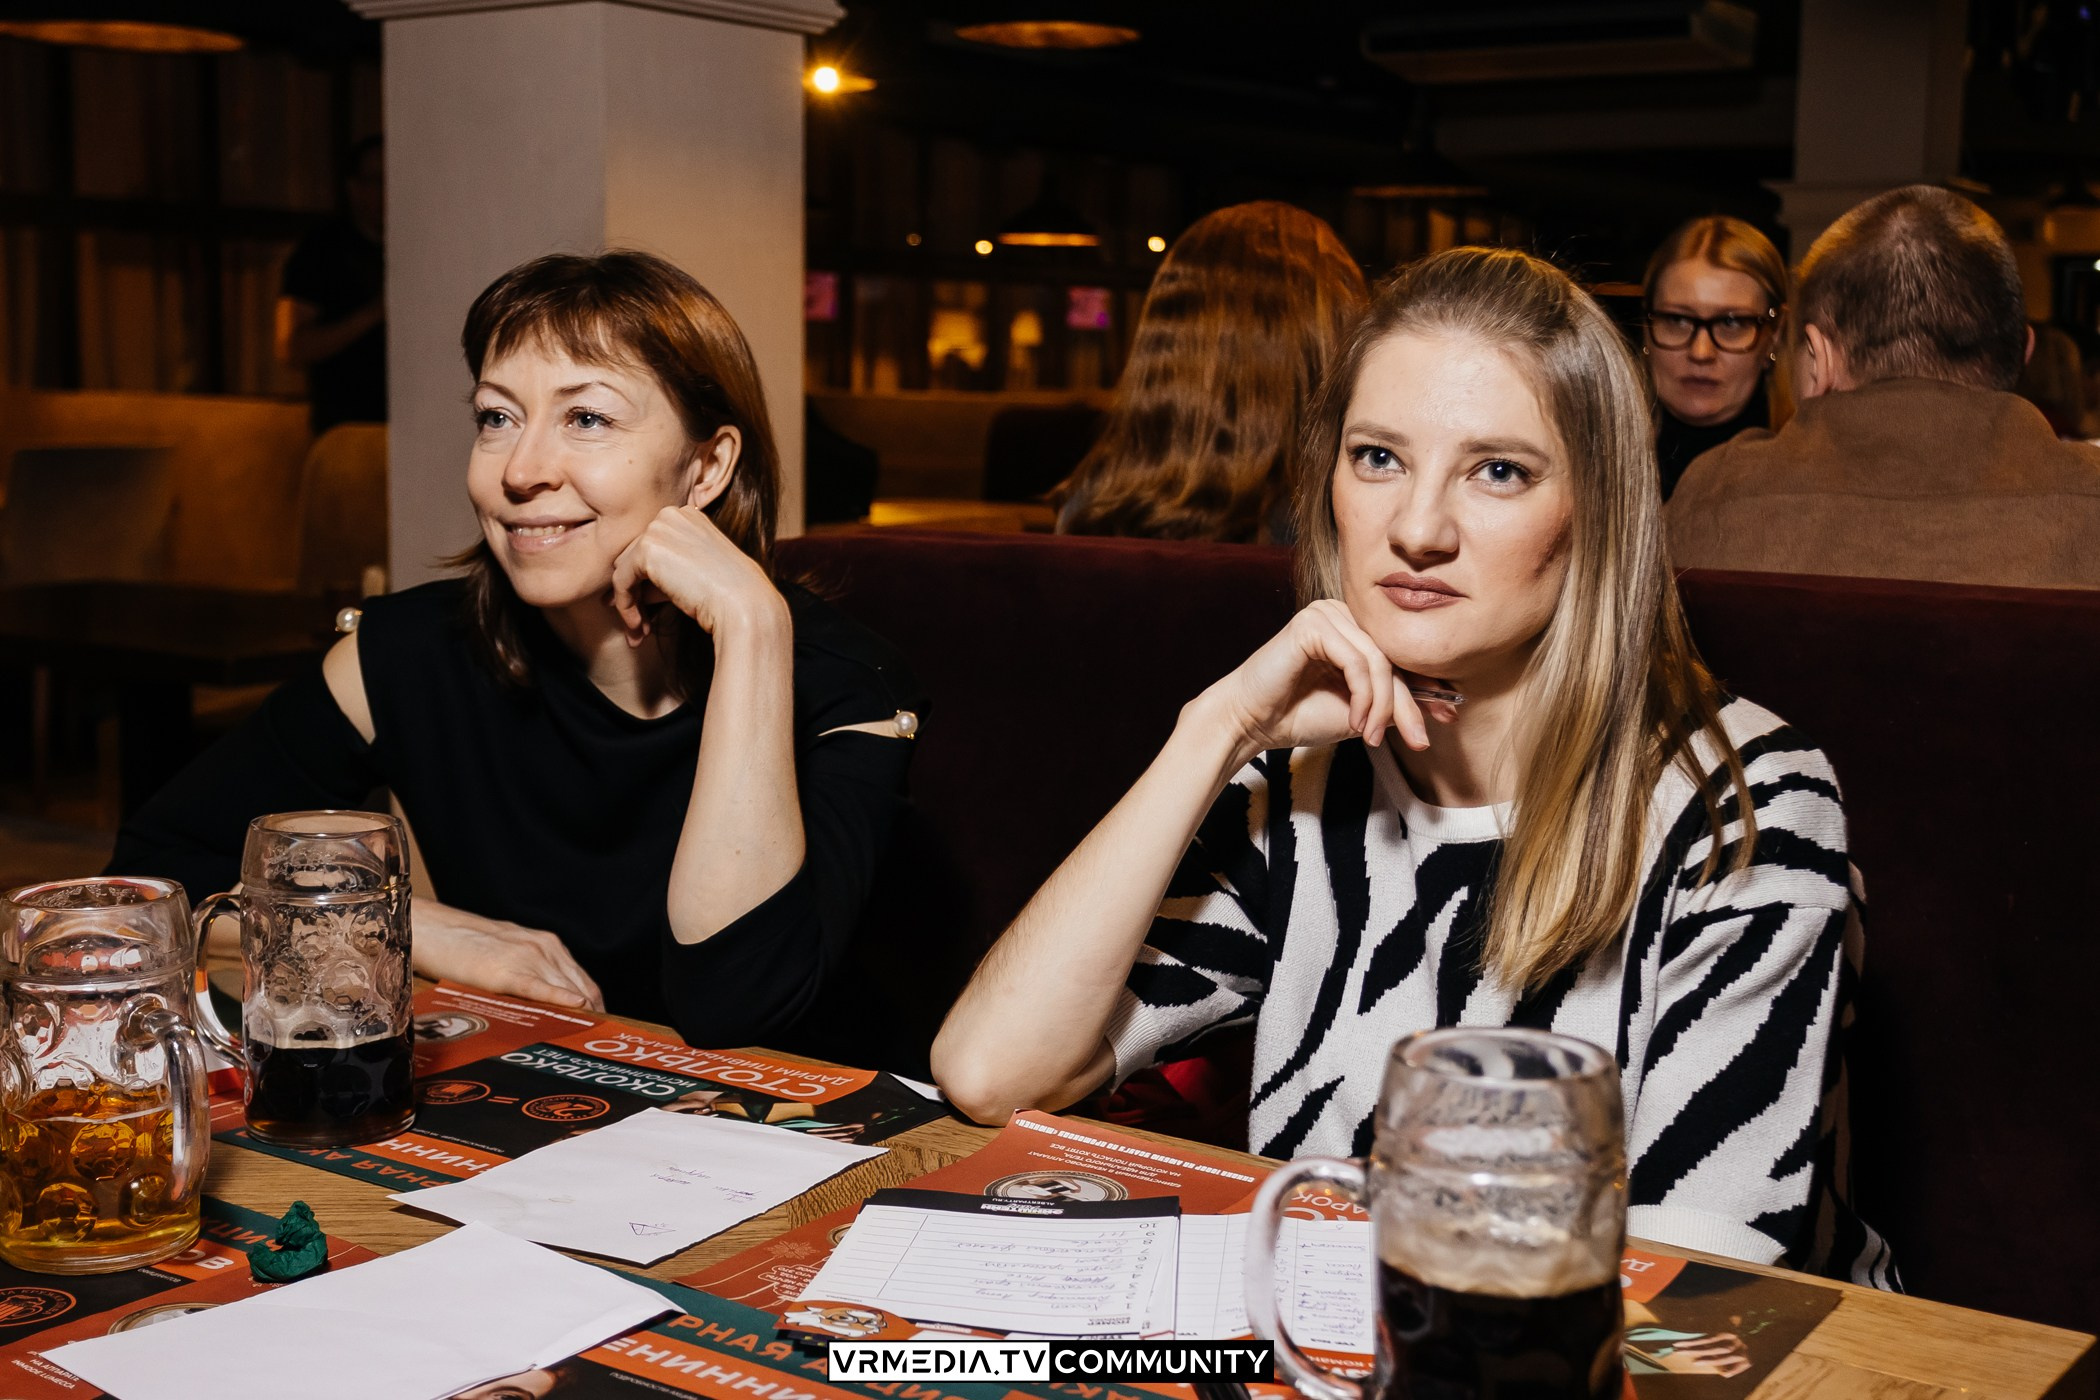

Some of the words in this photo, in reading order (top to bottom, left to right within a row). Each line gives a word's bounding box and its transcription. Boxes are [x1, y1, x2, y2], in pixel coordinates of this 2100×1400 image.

[611, 1032, 683, 1052] МАРОК
[532, 1048, 567, 1061] ЛЕТ
[685, 1048, 773, 1071] ПИВНЫХ
[500, 1053, 676, 1096] СКОЛЬКО
[569, 1057, 697, 1088] ИСПОЛНИЛОСЬ
[584, 1040, 826, 1097] СТОЛЬКО
[773, 1067, 853, 1086] ДАРИМ
[1027, 1150, 1064, 1162] АППАРАТ
[1065, 1159, 1107, 1172] КЕМЕРОВО
[1091, 1153, 1128, 1165] ПОПАСТЬ
[352, 1160, 449, 1189] РНАЯ
[1128, 1161, 1168, 1174] КОТОРЫЙ
[1290, 1191, 1366, 1214] АРОК
[667, 1314, 794, 1362] РНАЯ
